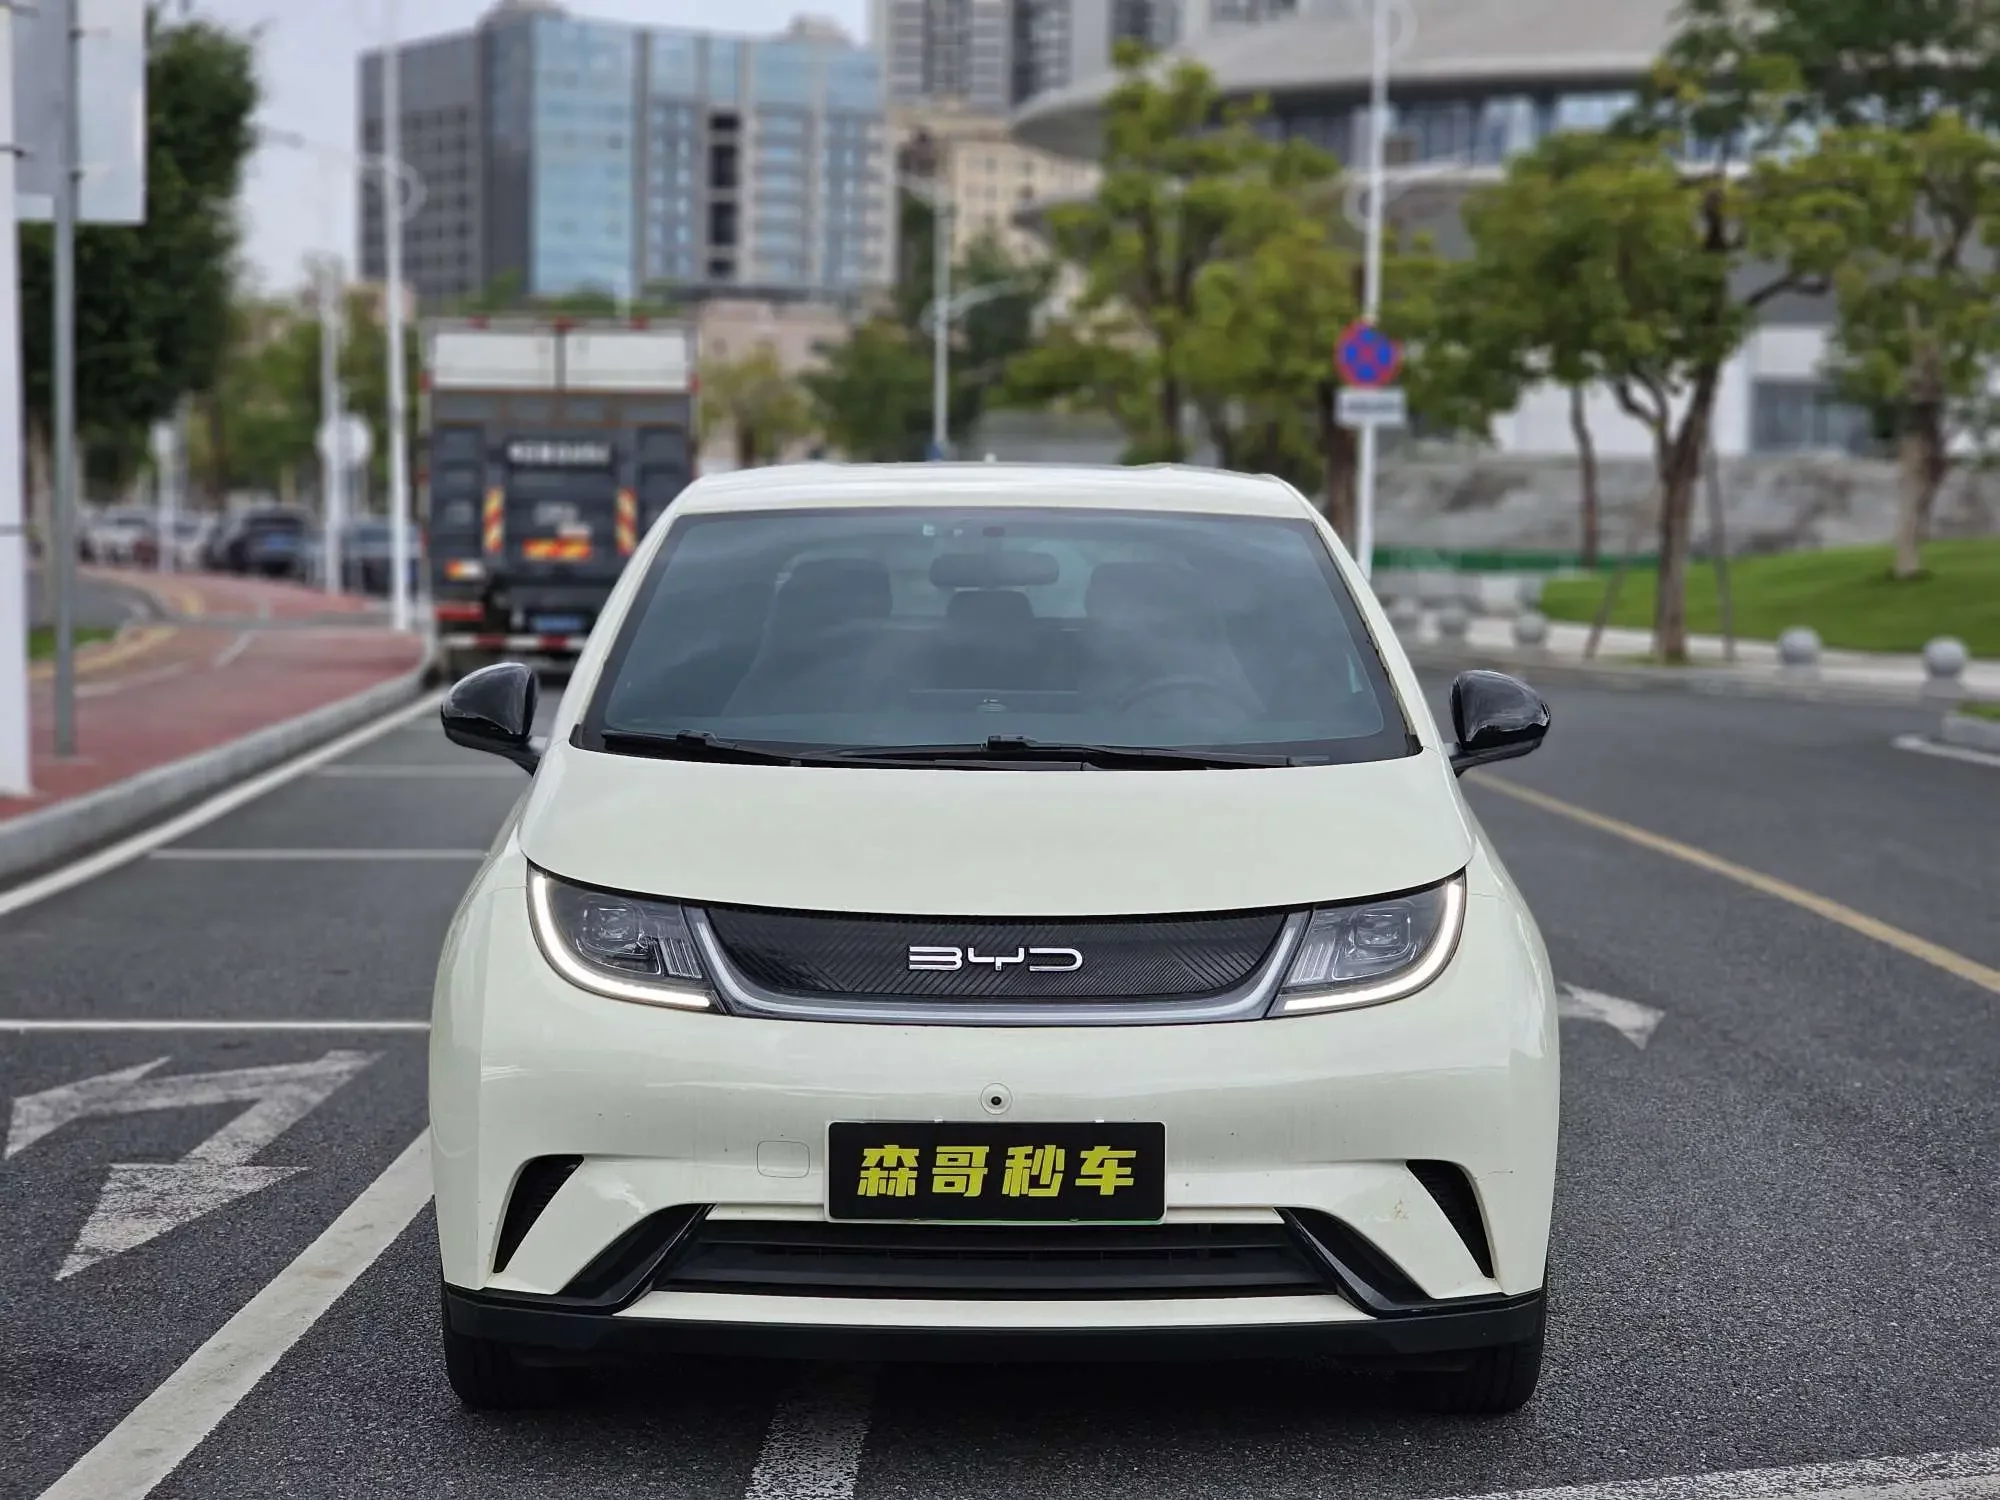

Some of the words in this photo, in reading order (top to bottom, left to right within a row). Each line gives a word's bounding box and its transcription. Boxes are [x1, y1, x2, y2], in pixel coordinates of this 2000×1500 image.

[909, 946, 1083, 972] BYD
[857, 1144, 1137, 1197] 森哥秒车
